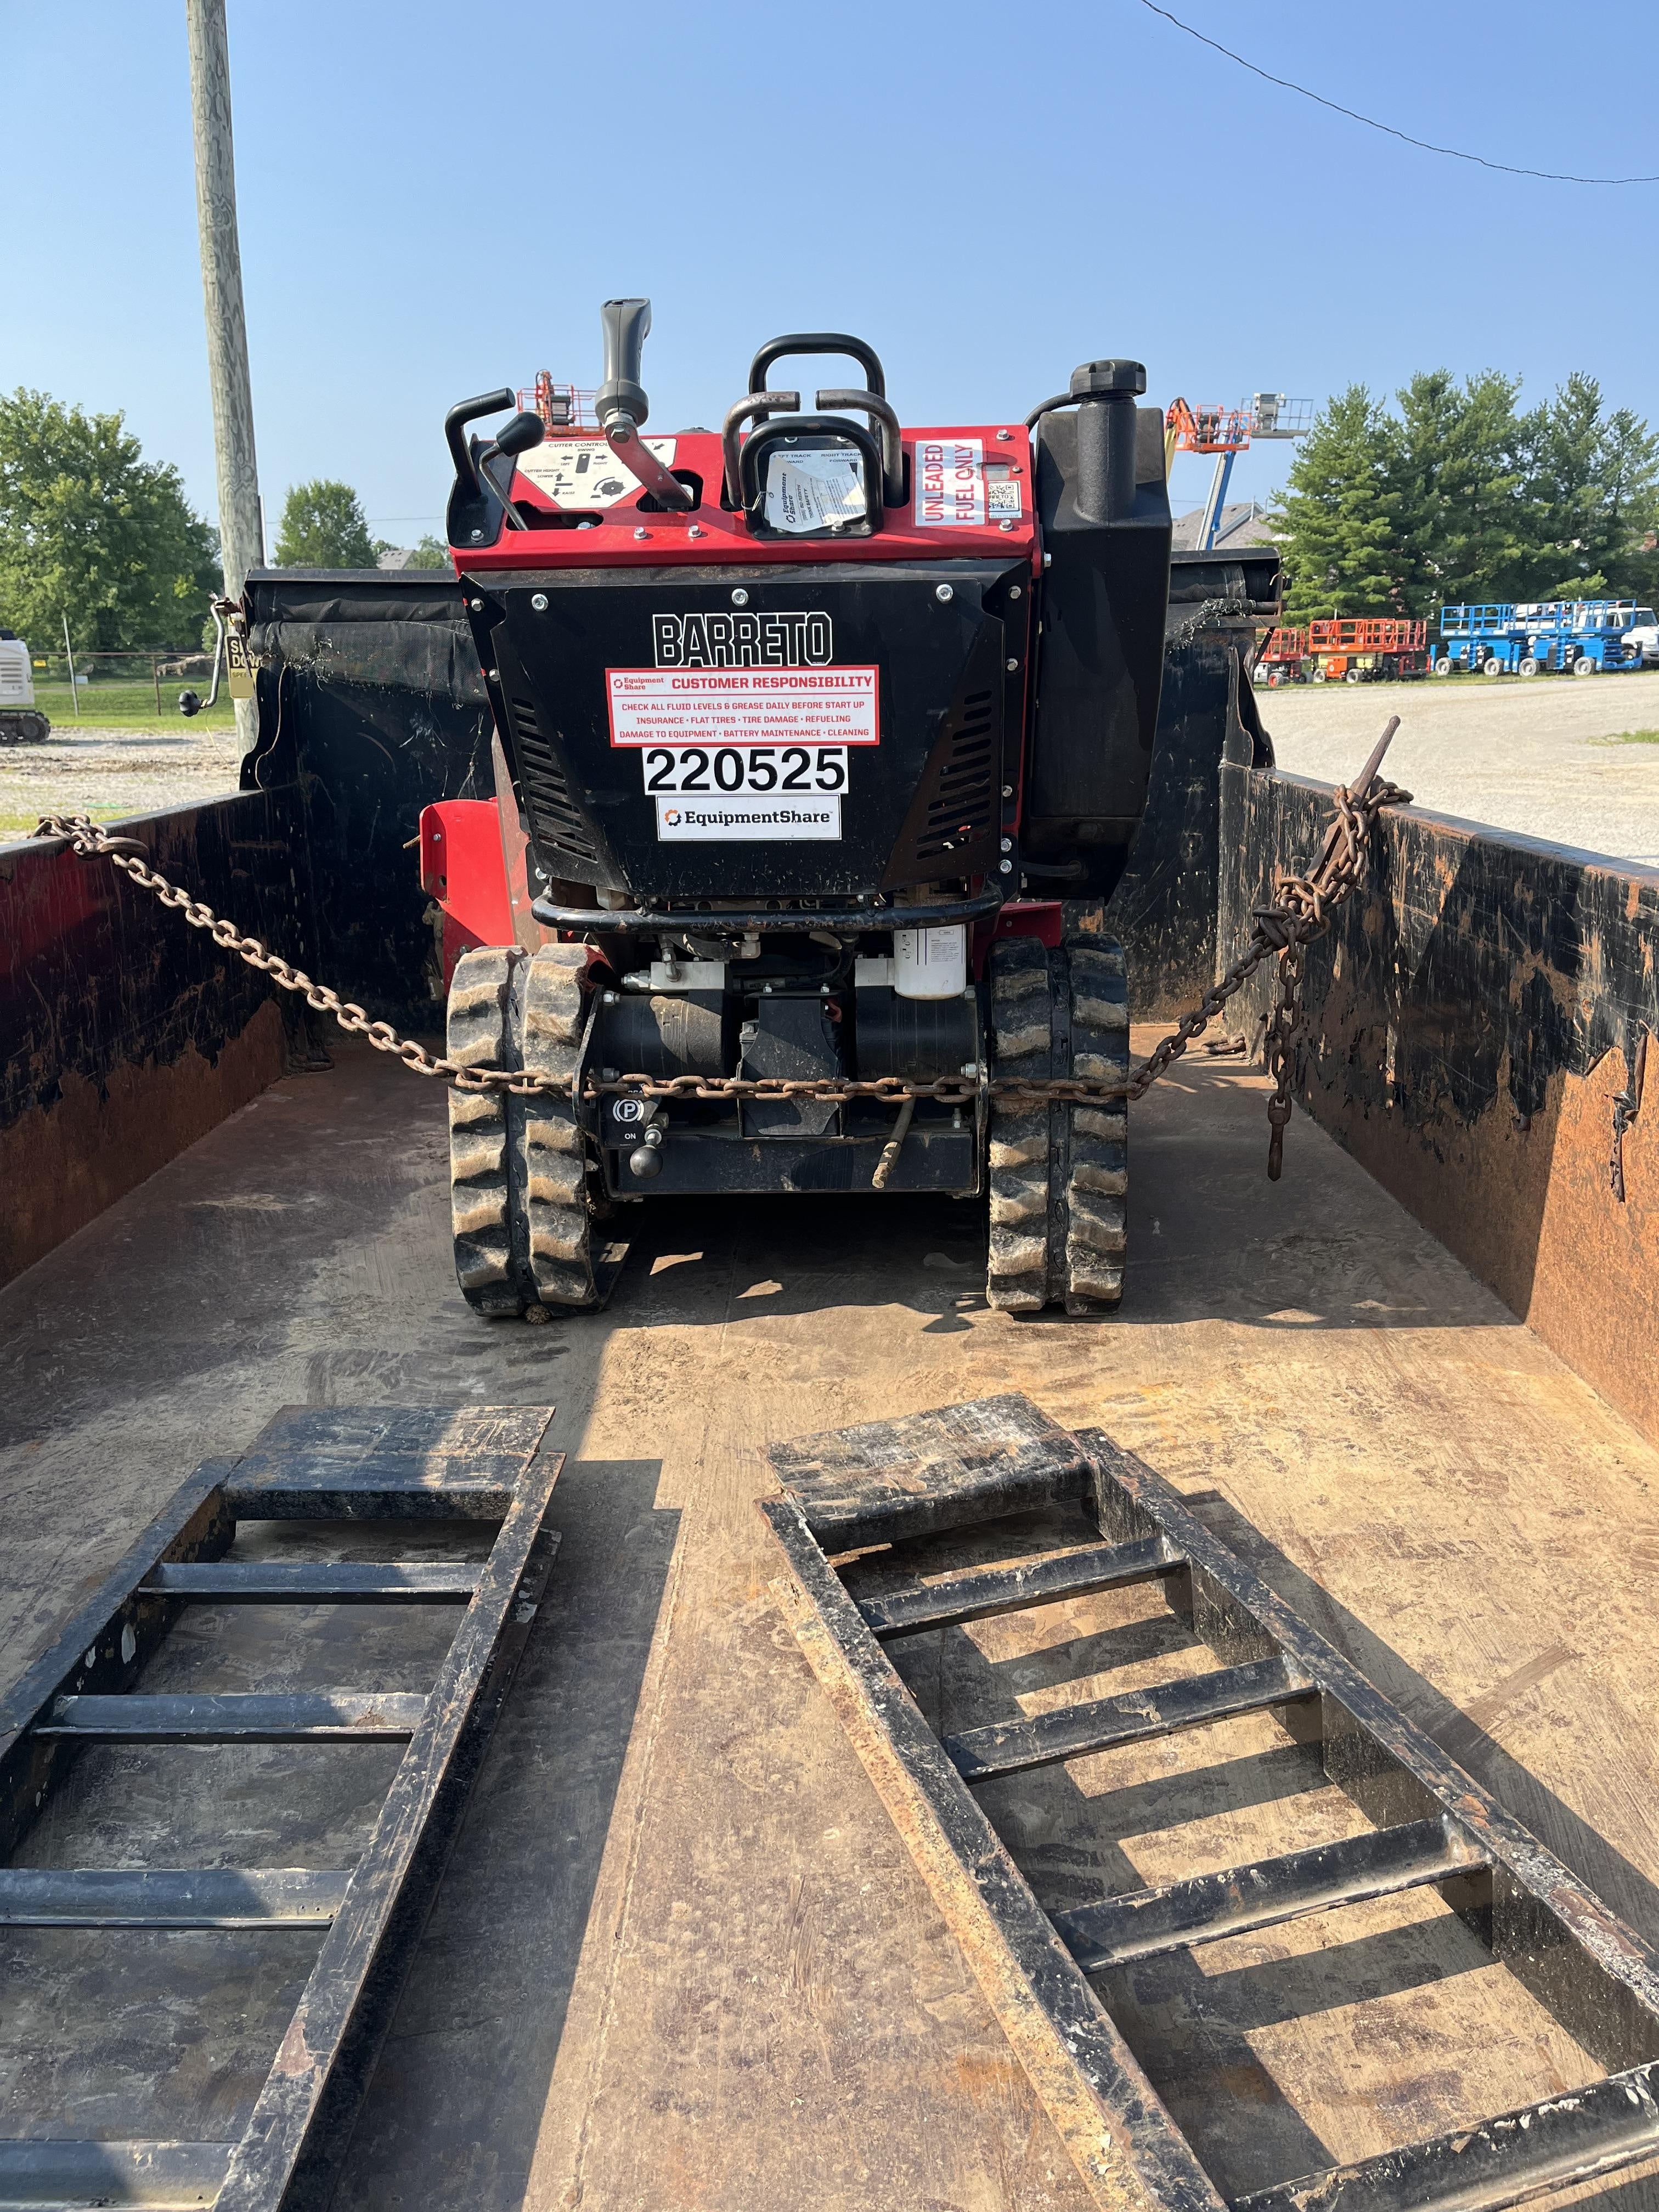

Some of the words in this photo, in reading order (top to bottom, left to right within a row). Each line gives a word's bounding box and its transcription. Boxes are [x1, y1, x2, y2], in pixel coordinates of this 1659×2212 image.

[955, 444, 973, 480] ONLY
[925, 445, 944, 521] UNLEADED
[956, 484, 975, 520] FUEL
[652, 612, 833, 668] BARRETO
[672, 677, 749, 689] CUSTOMER
[753, 676, 872, 688] RESPONSIBILITY
[669, 730, 717, 738] EQUIPMENT
[646, 747, 845, 792] 220525
[685, 810, 830, 826] EquipmentShare
[624, 1103, 636, 1118] P
